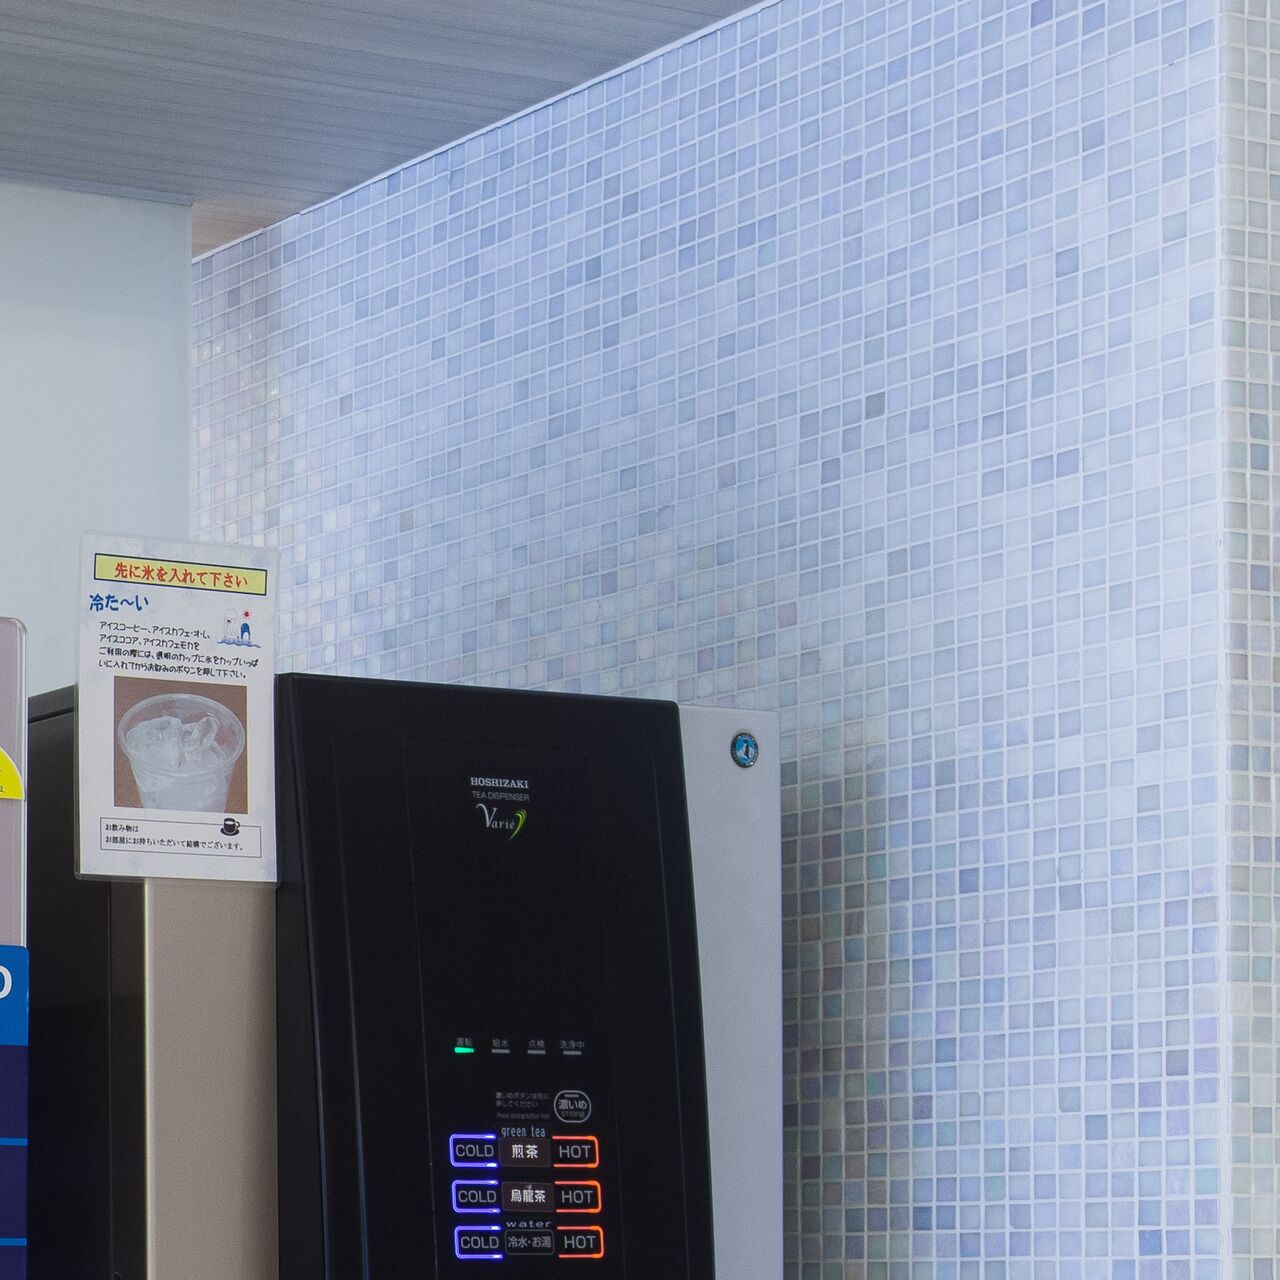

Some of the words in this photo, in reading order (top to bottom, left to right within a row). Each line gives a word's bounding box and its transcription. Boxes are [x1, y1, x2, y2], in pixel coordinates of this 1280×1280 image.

[115, 562, 248, 588] 先に氷を入れて下さい
[470, 777, 528, 789] HOSHIZAKI
[472, 790, 486, 799] TEA
[488, 791, 529, 802] DISPENSER
[105, 824, 139, 832] お飲み物は
[559, 1099, 587, 1110] 濃いめ
[502, 1127, 526, 1137] green
[531, 1126, 546, 1137] tea
[456, 1145, 494, 1157] COLD
[512, 1144, 538, 1159] 煎茶
[560, 1146, 591, 1158] HOT
[458, 1191, 497, 1202] COLD
[511, 1189, 546, 1202] 烏龍茶
[562, 1191, 593, 1203] HOT
[506, 1220, 551, 1228] water
[460, 1237, 499, 1248] COLD
[508, 1236, 551, 1248] 冷水・お湯
[564, 1236, 596, 1248] HOT
